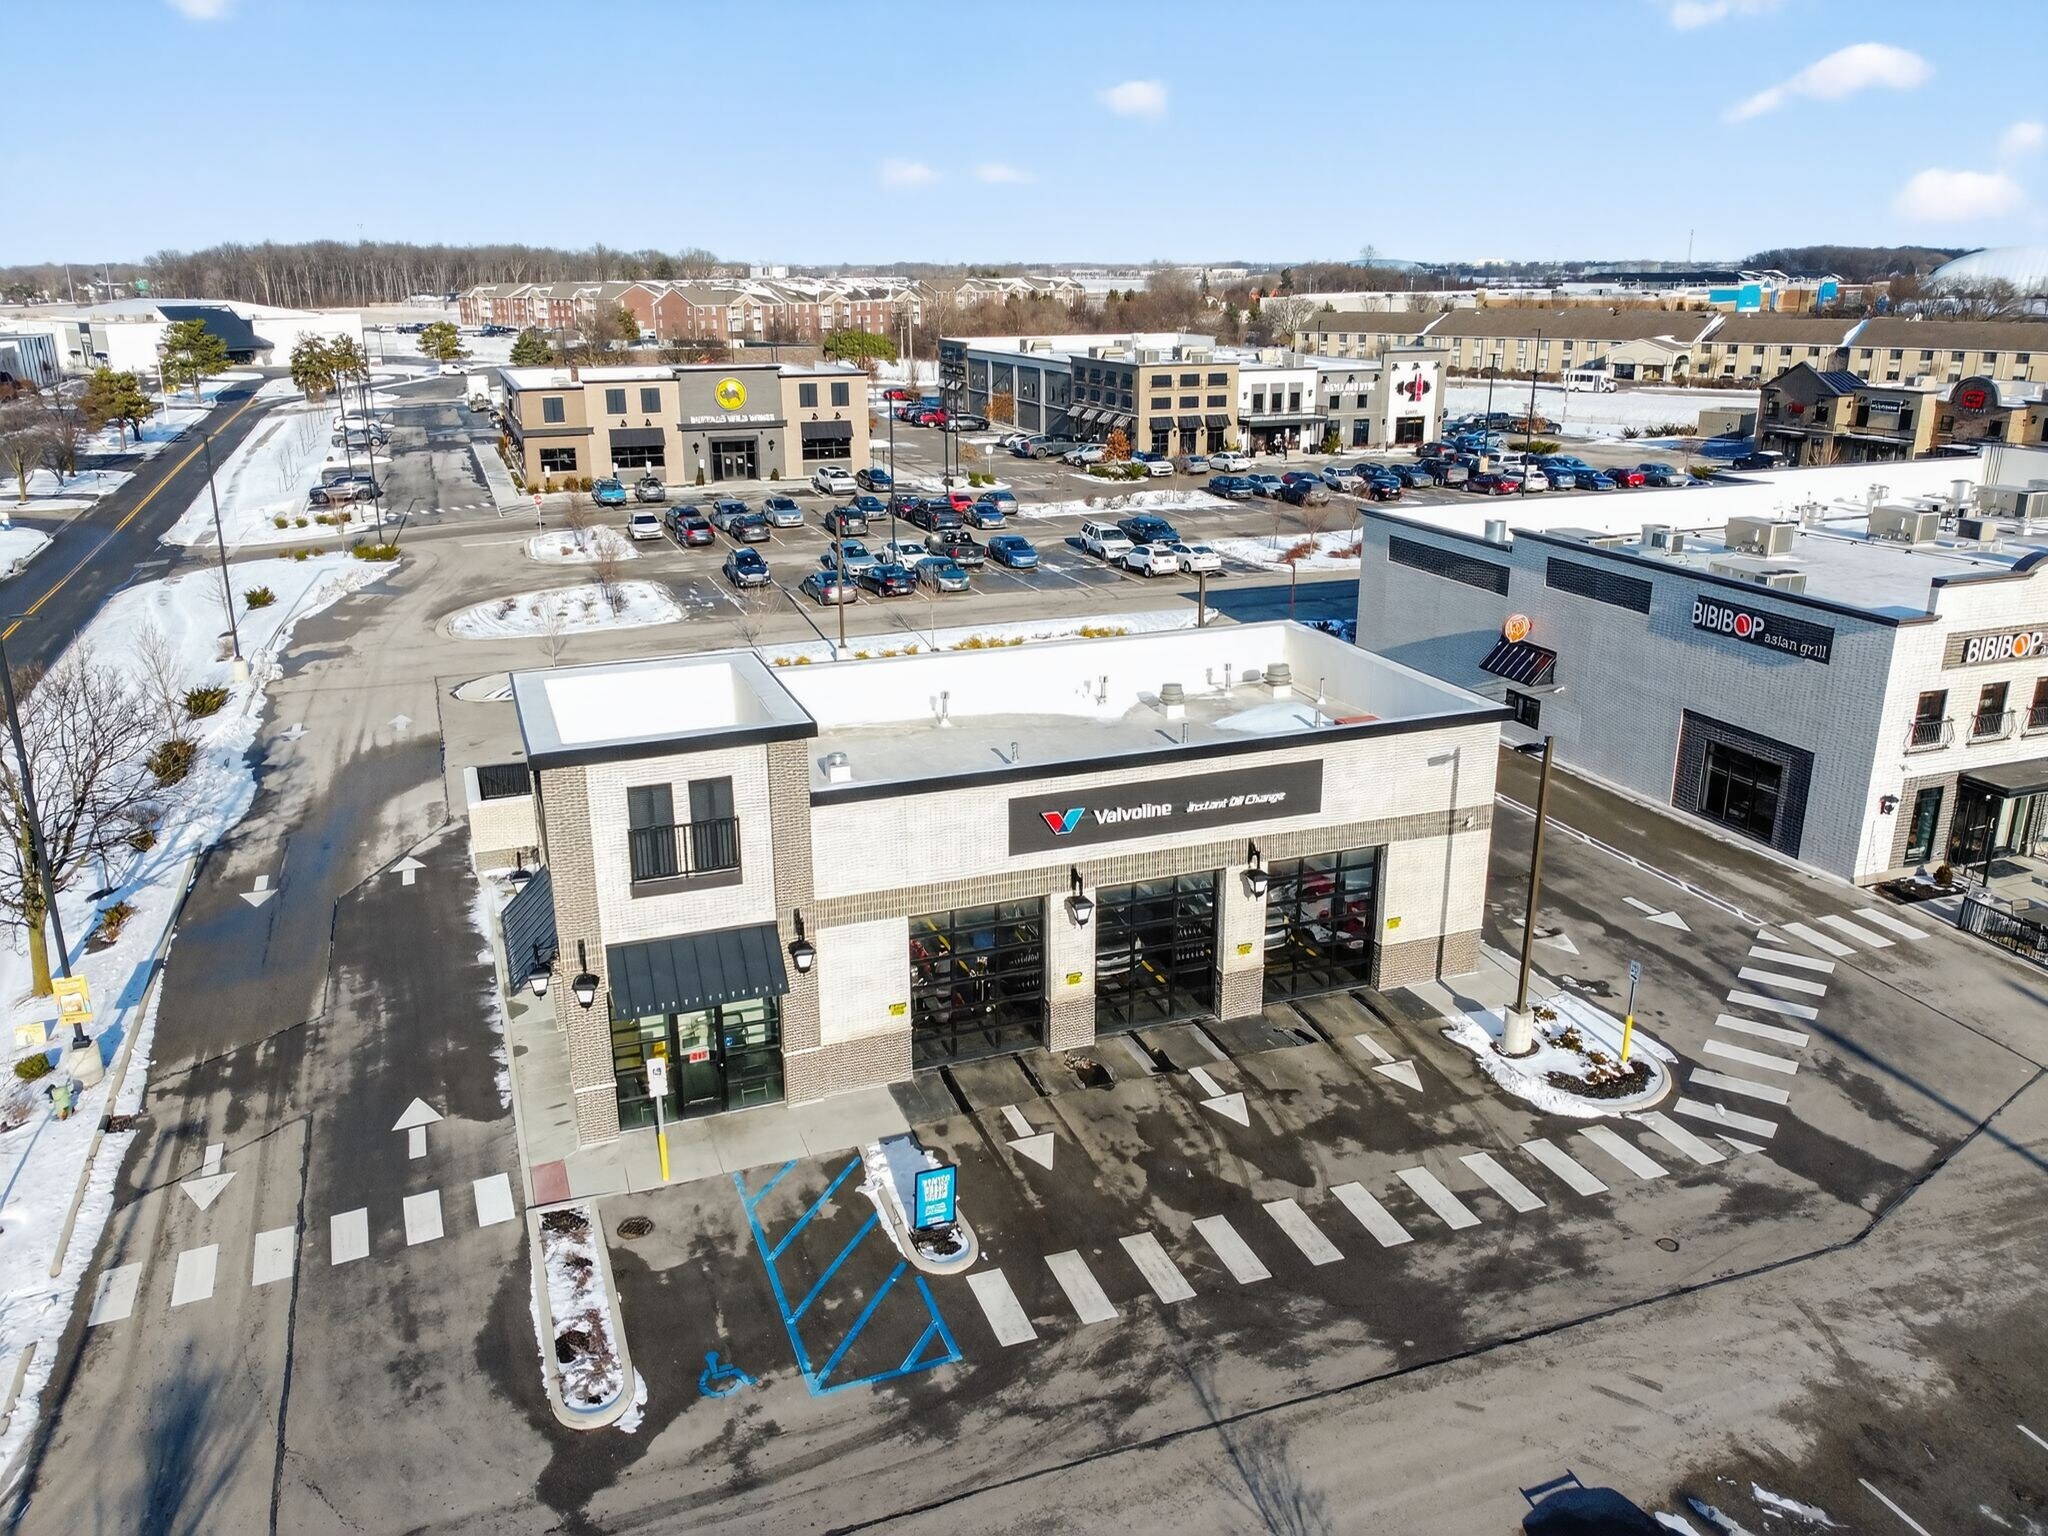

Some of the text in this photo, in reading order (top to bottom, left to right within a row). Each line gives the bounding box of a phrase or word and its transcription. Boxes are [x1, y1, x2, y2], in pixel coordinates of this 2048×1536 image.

[1691, 601, 1765, 639] BIBIBOP
[1764, 633, 1827, 659] asian grill
[1966, 632, 2043, 663] BIBIBOP
[1094, 803, 1172, 824] Valvoline
[1186, 799, 1228, 813] Instant
[1245, 792, 1286, 804] Change
